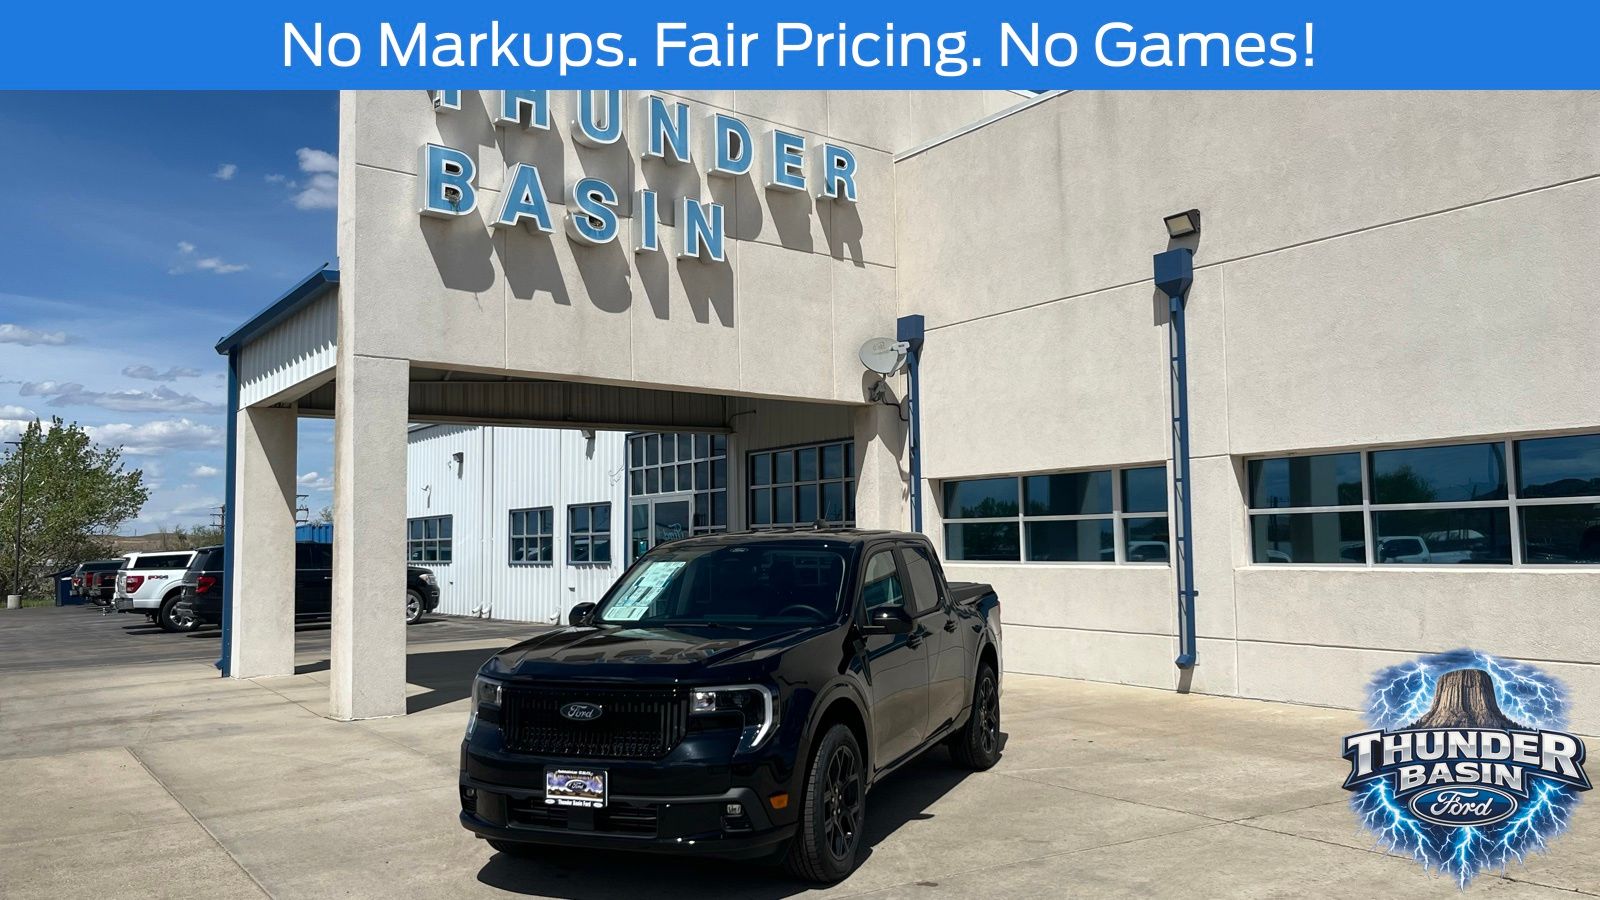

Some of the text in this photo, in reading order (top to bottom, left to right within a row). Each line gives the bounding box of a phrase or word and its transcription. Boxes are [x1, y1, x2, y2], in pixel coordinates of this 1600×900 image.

[419, 143, 725, 263] BASIN
[434, 90, 858, 203] HUNDER
[567, 704, 594, 718] Ford
